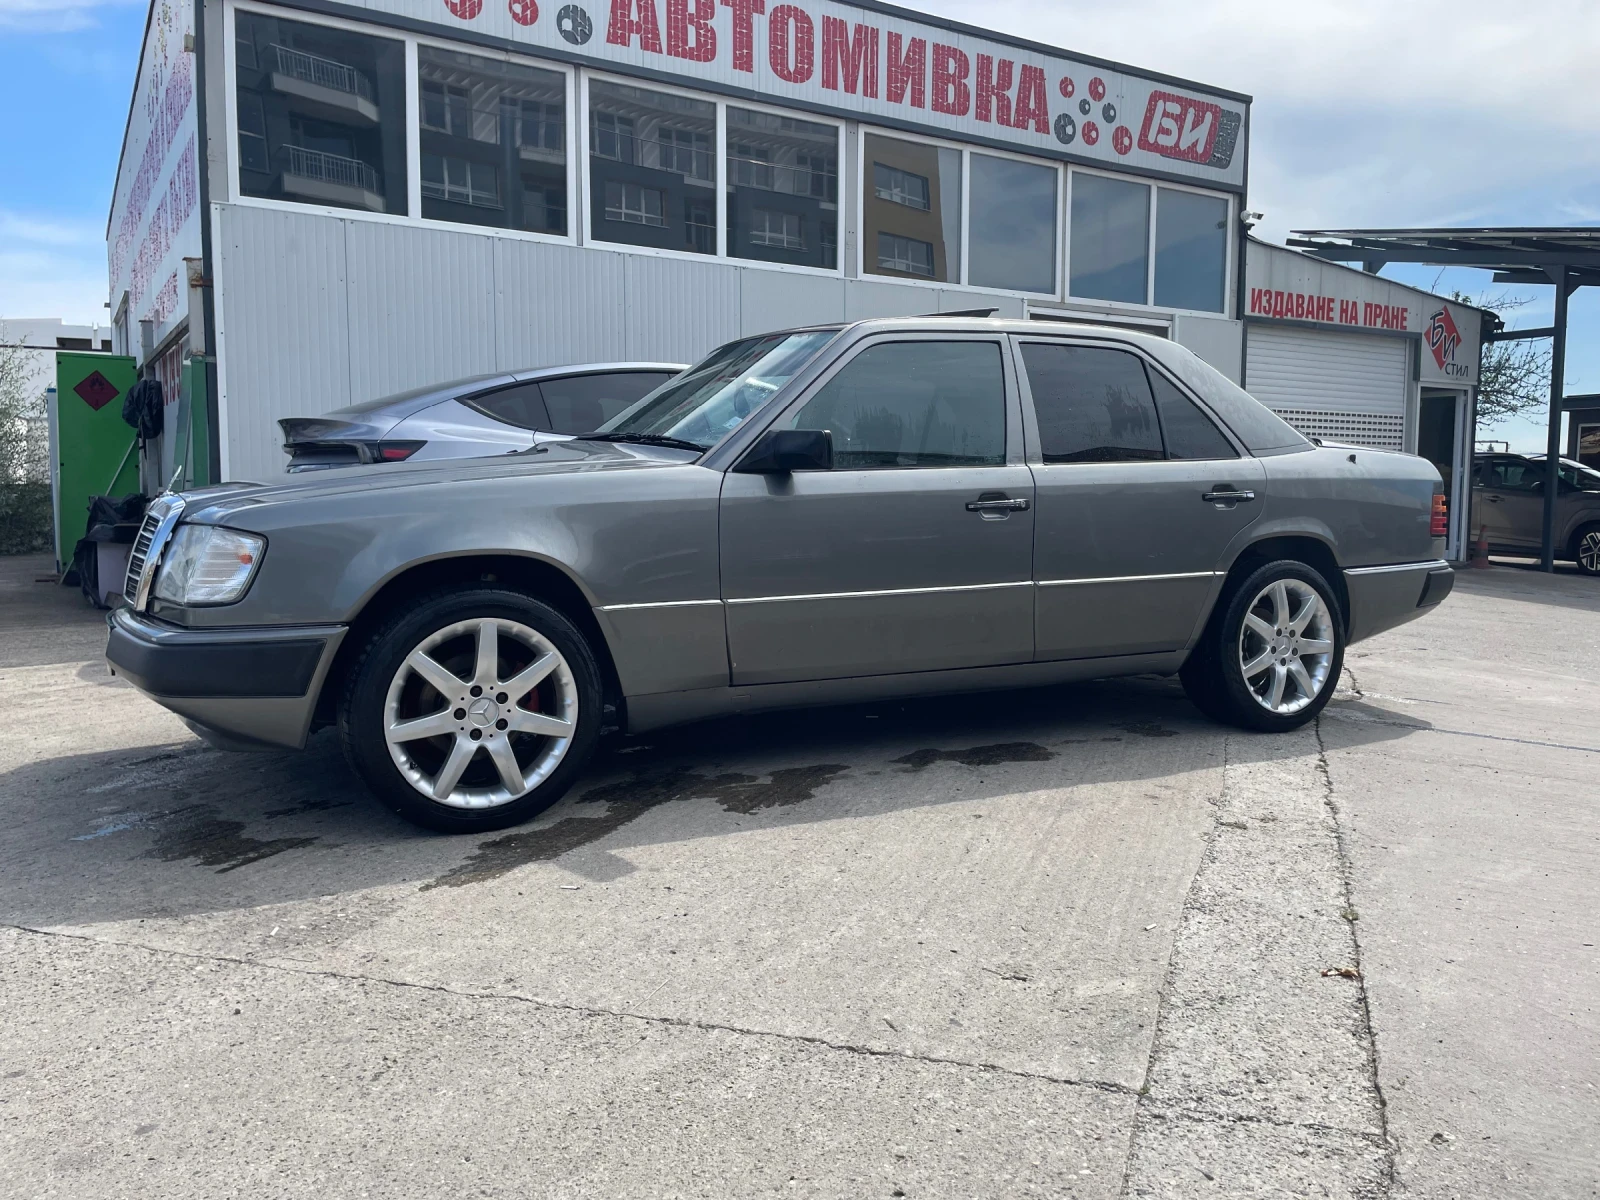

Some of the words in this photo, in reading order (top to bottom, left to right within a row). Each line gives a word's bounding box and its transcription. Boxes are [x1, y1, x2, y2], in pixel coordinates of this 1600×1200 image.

[605, 0, 1050, 136] АВТОМИВКА
[1147, 99, 1213, 154] БИ
[1250, 287, 1335, 322] ИЗДАВАНЕ
[1339, 299, 1358, 325] НА
[1363, 302, 1408, 330] ПРАНЕ
[1444, 362, 1469, 377] СТИЛ
